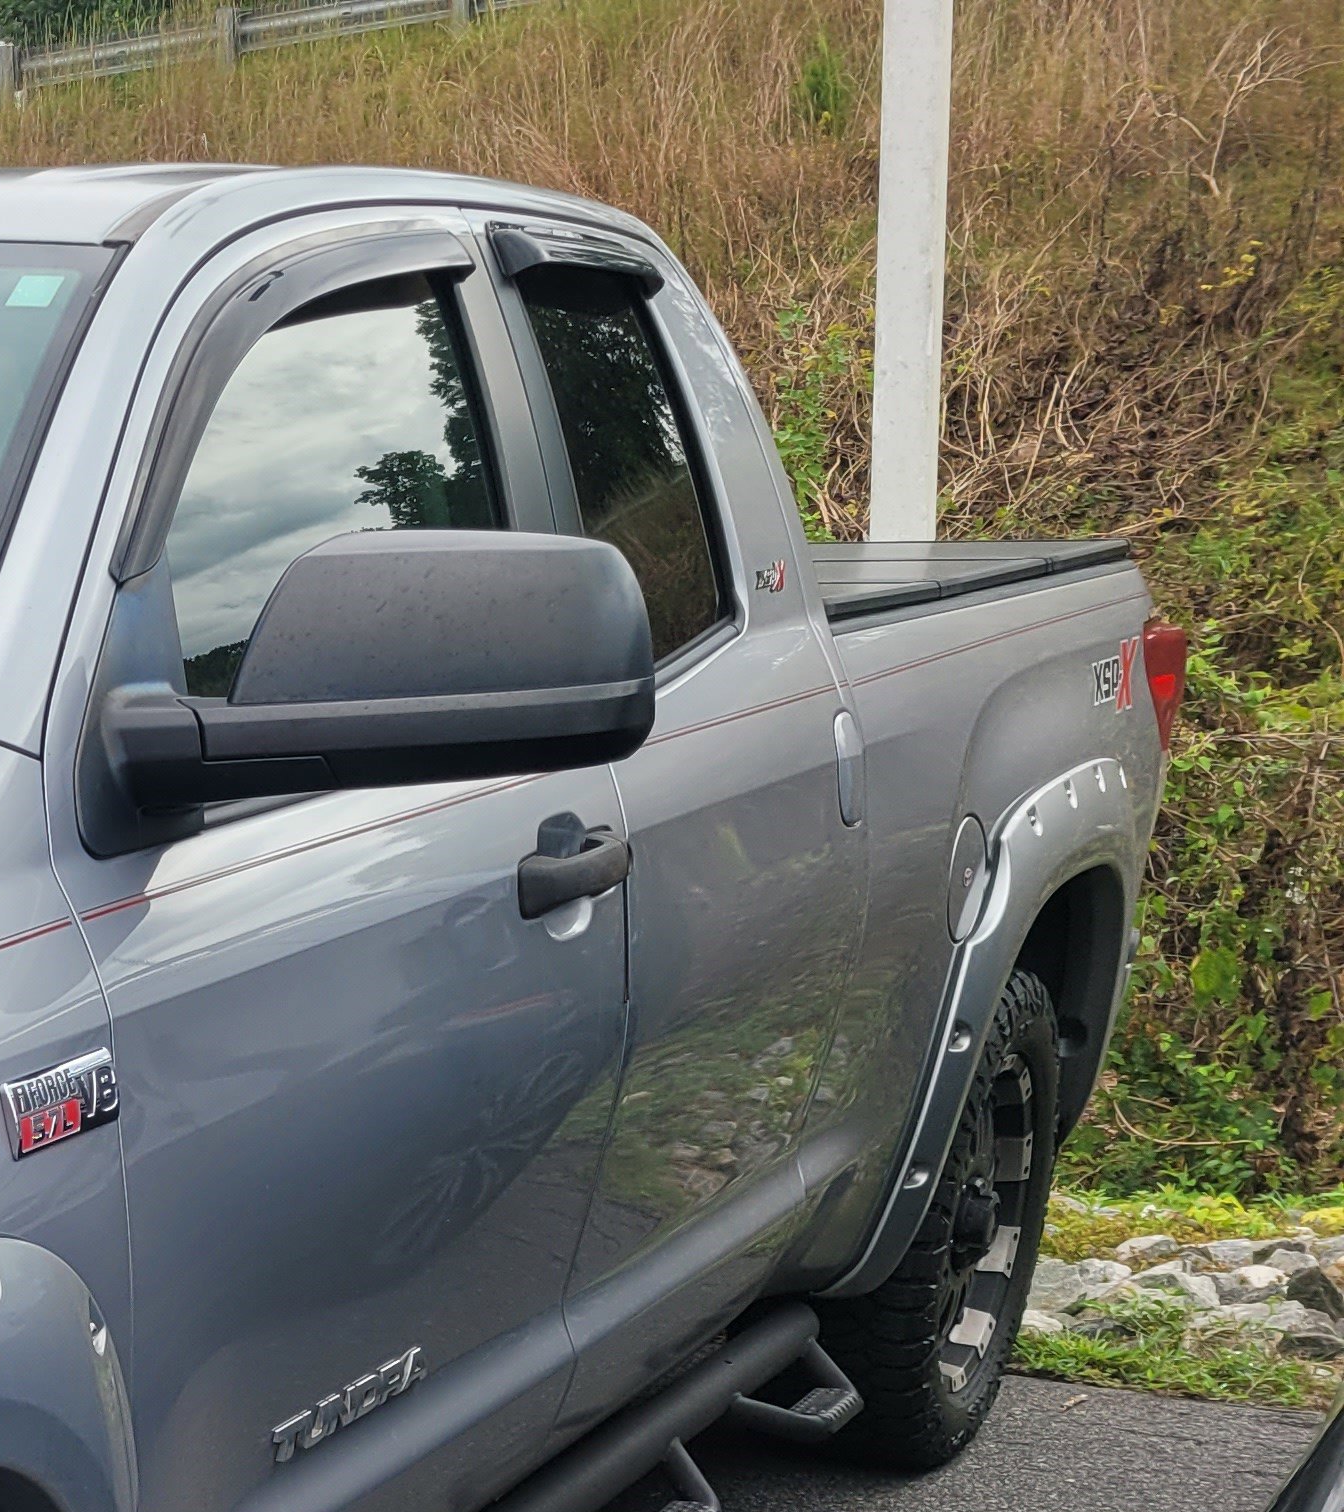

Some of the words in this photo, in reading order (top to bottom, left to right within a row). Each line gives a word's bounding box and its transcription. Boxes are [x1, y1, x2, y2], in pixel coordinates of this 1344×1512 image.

[77, 1066, 118, 1118] V8
[30, 1103, 75, 1144] 5.7L
[271, 1345, 428, 1462] TUNDRA
